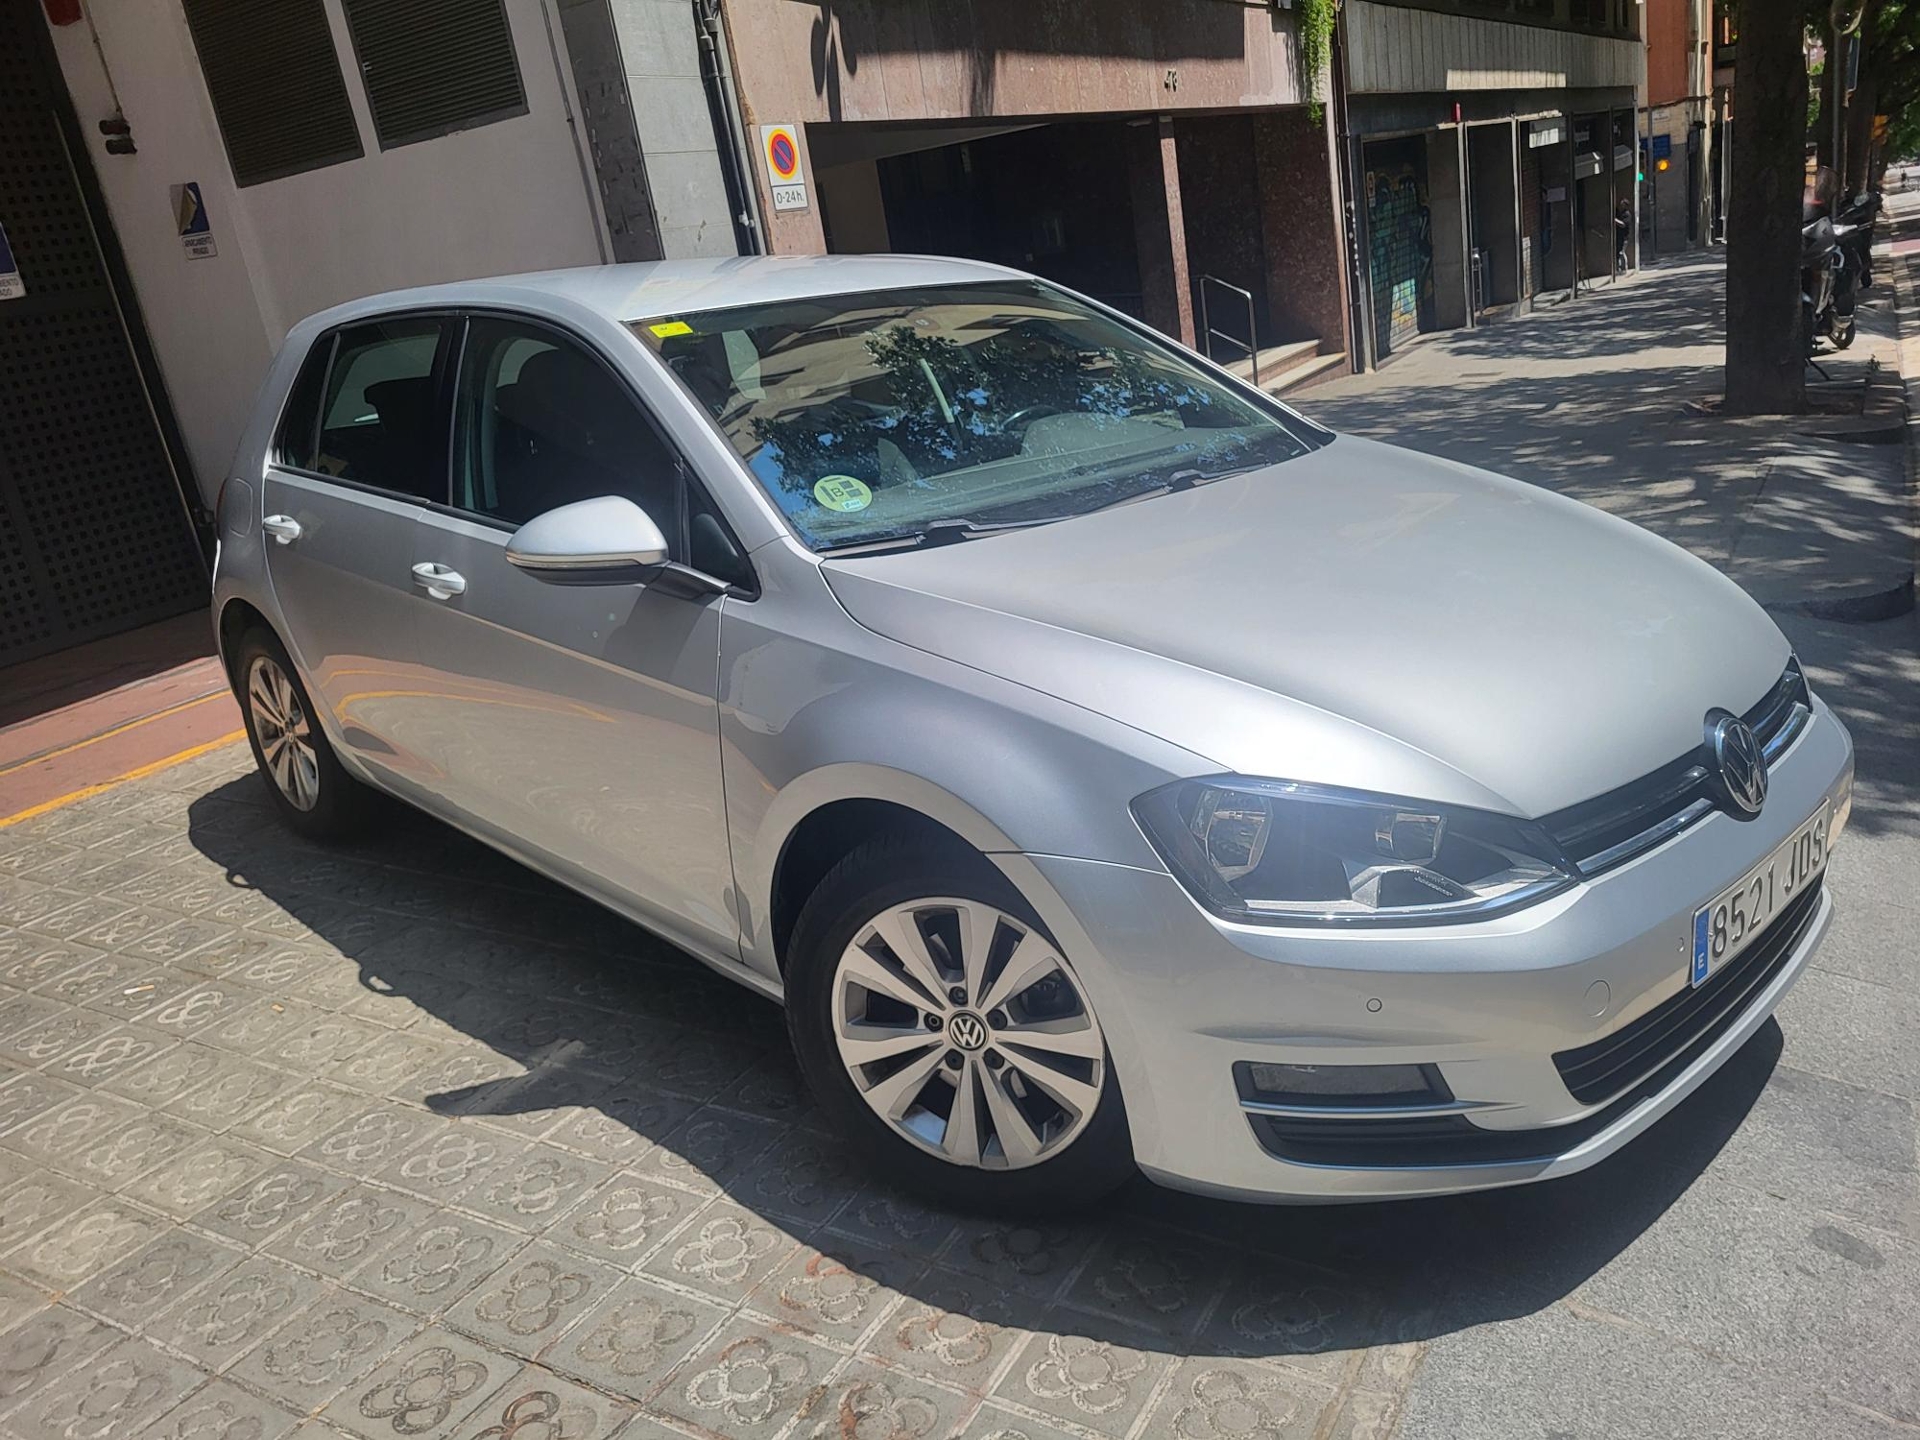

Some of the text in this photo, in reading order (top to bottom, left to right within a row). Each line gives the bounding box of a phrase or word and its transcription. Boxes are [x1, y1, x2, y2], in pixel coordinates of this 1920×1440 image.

[832, 488, 844, 497] B
[1711, 819, 1823, 960] 8521 JDS
[1697, 953, 1705, 969] E
